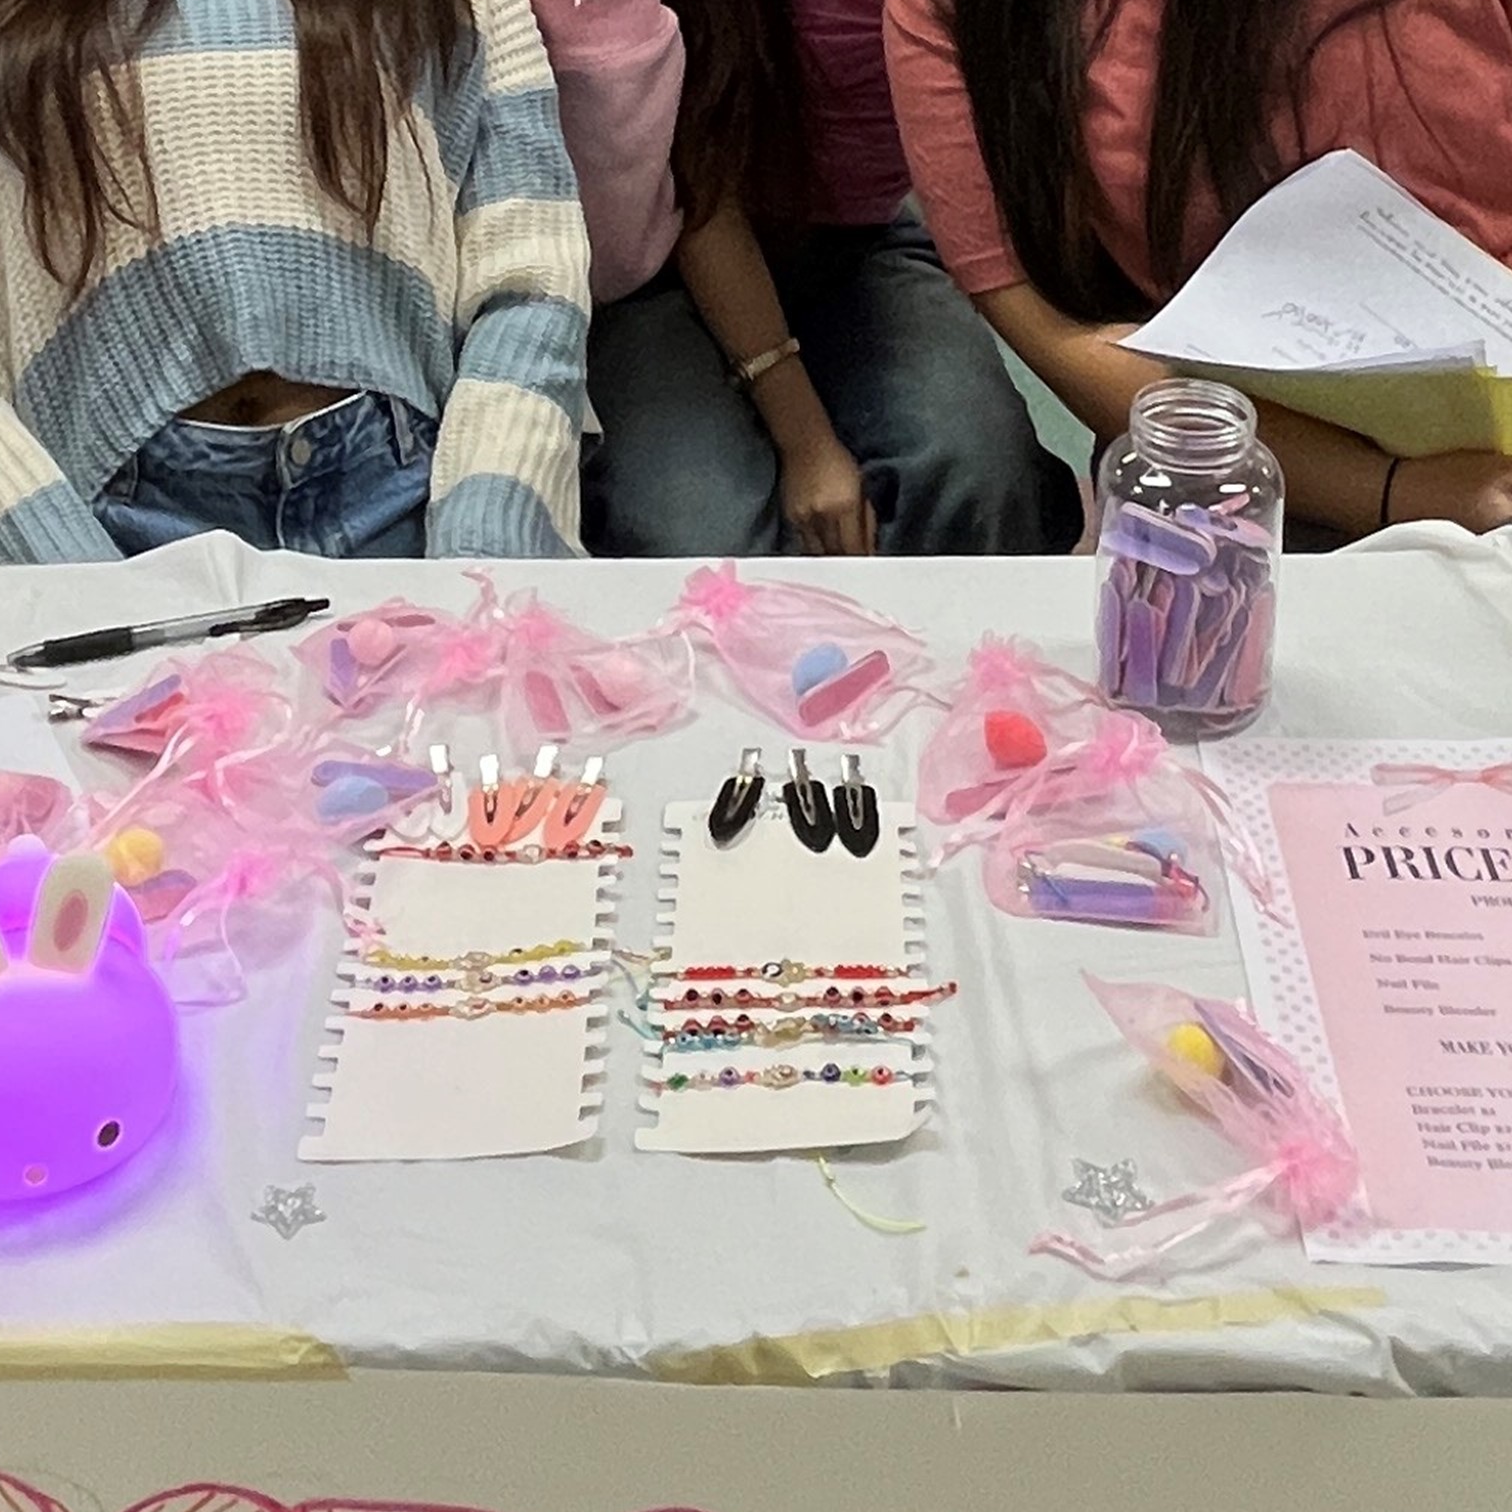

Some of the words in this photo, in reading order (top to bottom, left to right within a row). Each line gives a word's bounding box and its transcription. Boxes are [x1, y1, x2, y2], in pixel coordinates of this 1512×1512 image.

[1438, 1039, 1492, 1056] MAKE
[1405, 1085, 1483, 1098] CHOOSE
[1417, 1122, 1451, 1134] Hair
[1456, 1122, 1490, 1136] Clip
[1422, 1139, 1457, 1151] Nail
